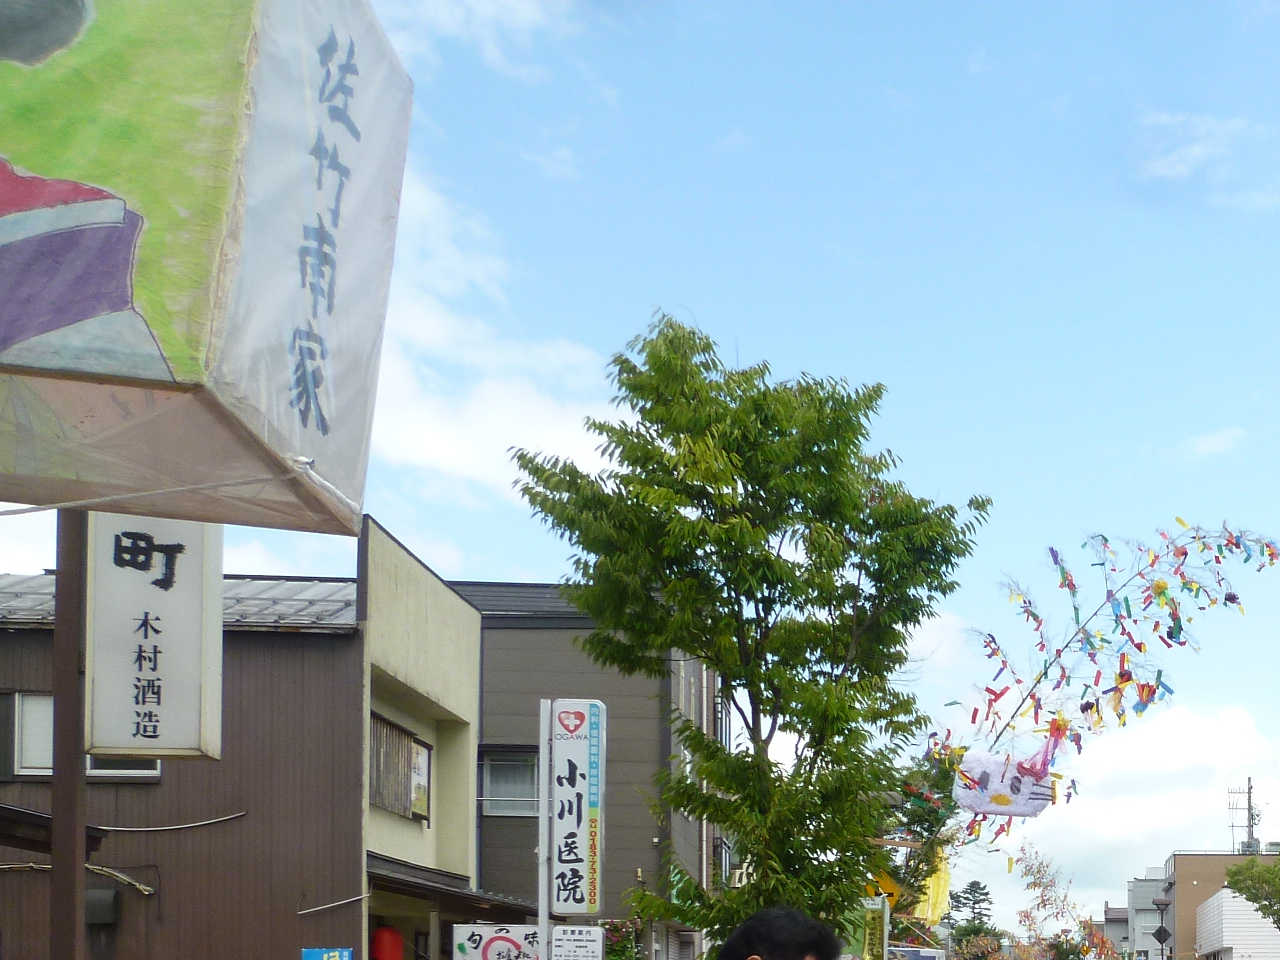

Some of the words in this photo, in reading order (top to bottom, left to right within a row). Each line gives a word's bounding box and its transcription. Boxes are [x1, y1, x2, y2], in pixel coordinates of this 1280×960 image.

[289, 24, 361, 437] 佐竹南家
[113, 530, 186, 591] 町
[131, 611, 163, 739] 木村酒造
[555, 733, 589, 741] OGAWA
[555, 758, 586, 905] 小川医院
